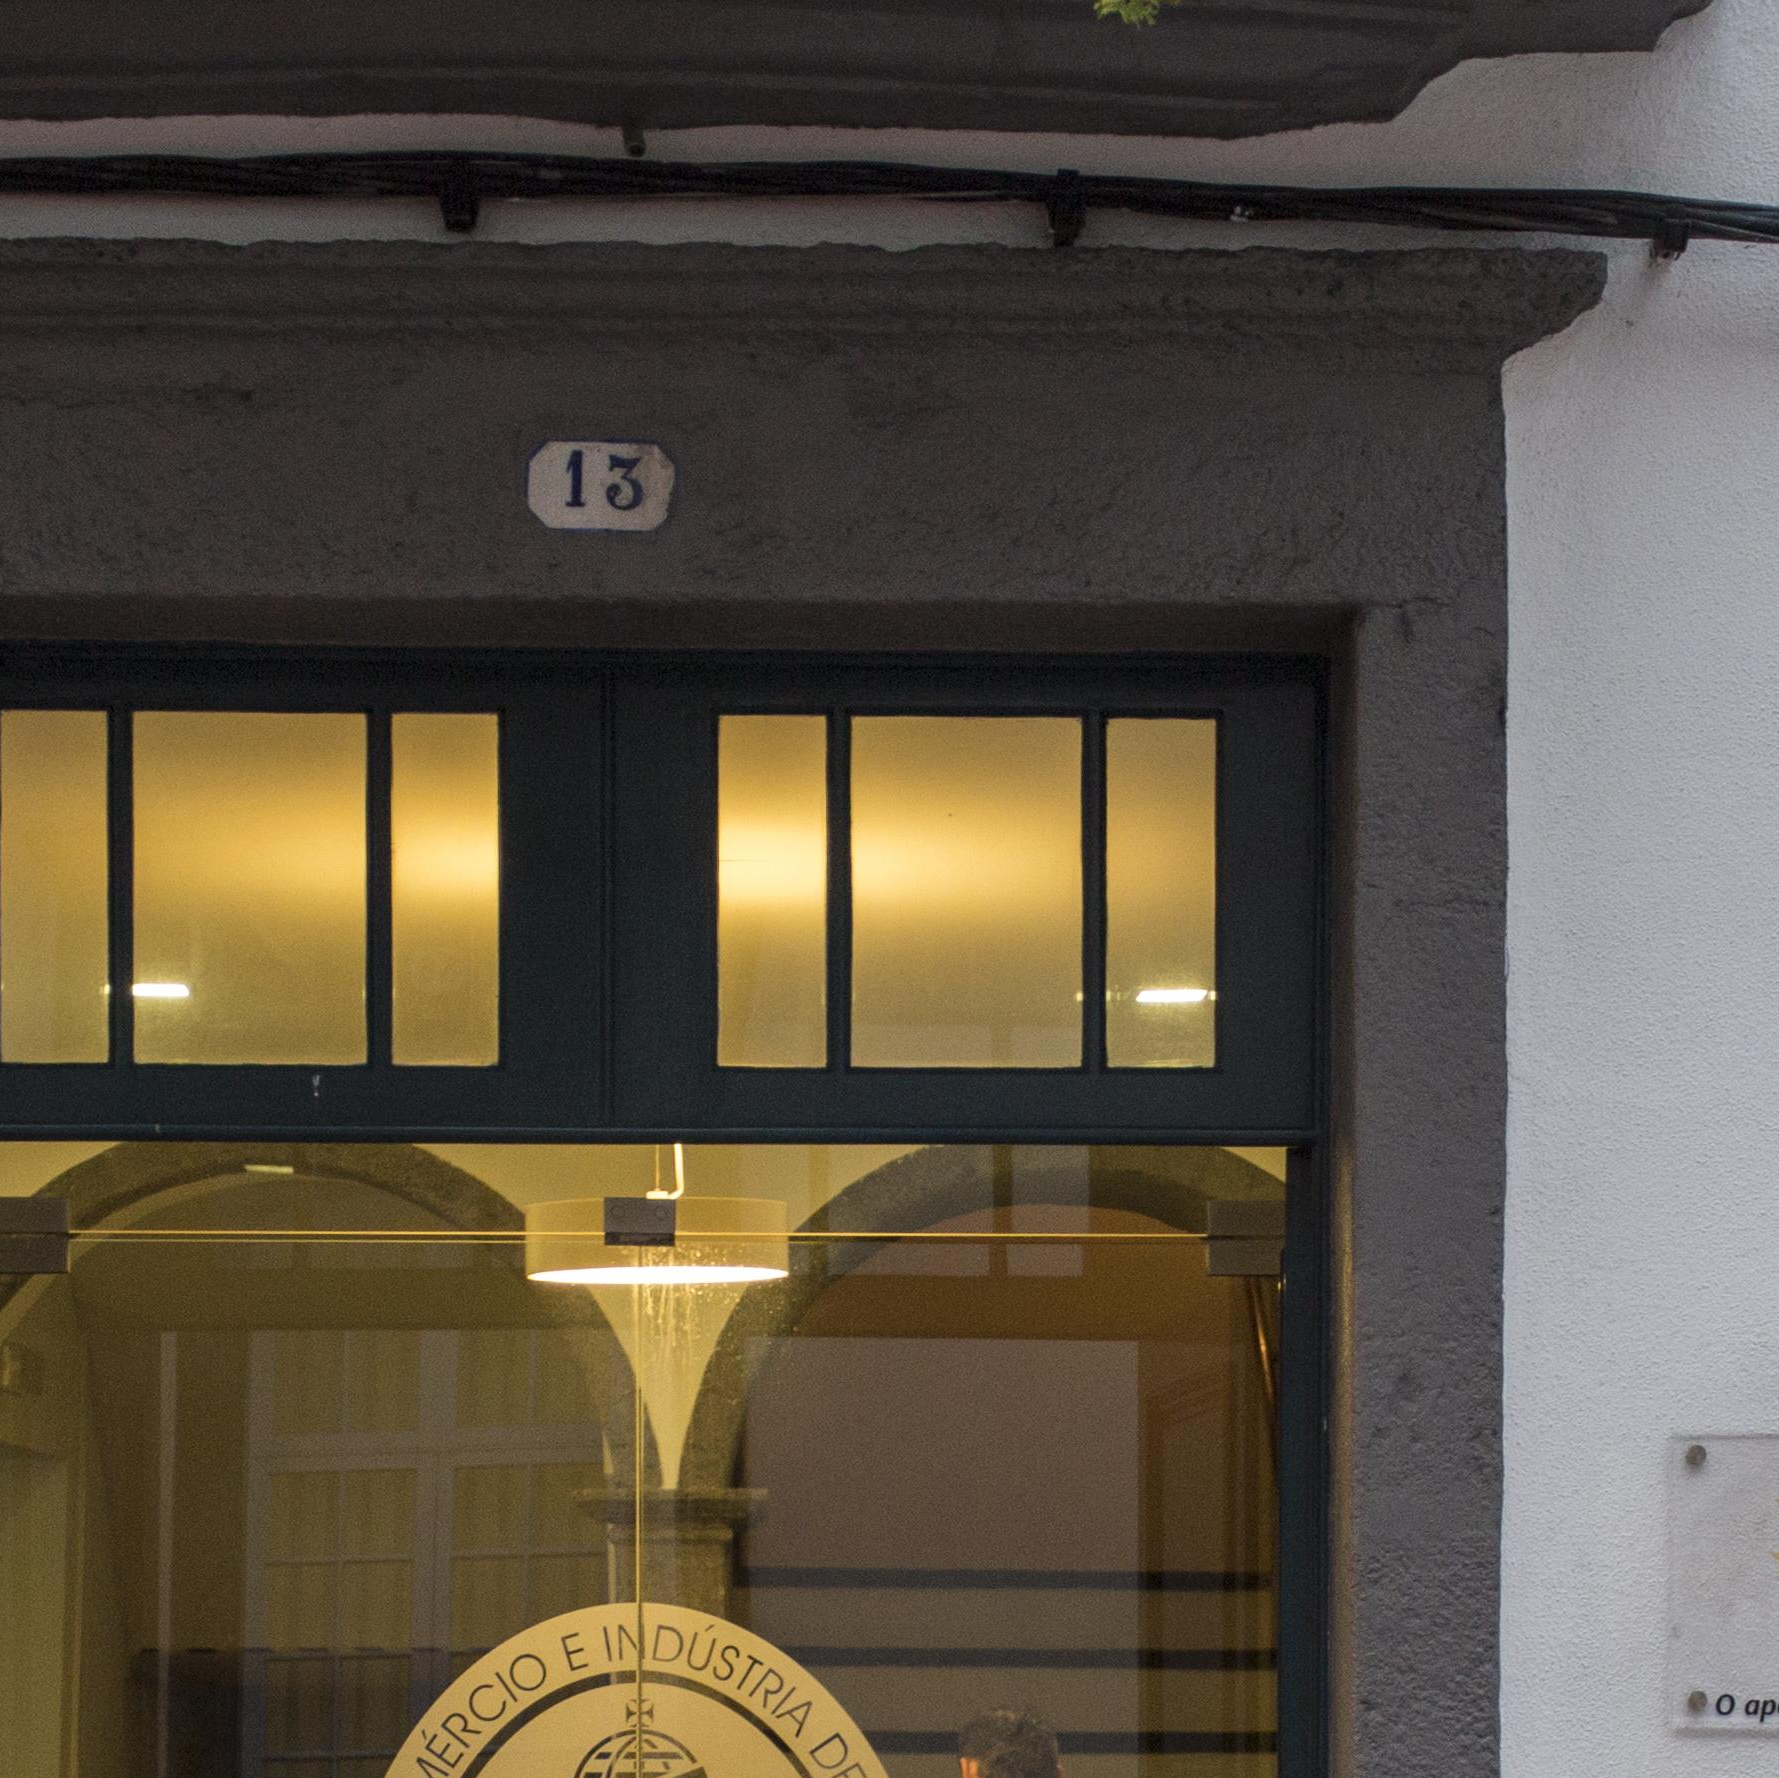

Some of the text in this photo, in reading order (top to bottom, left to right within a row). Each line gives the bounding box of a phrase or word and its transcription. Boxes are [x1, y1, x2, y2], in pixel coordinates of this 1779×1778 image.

[565, 450, 643, 510] 13
[560, 1632, 590, 1672] E
[603, 1624, 813, 1738] INDÚSTRIA
[1716, 1693, 1736, 1716] O
